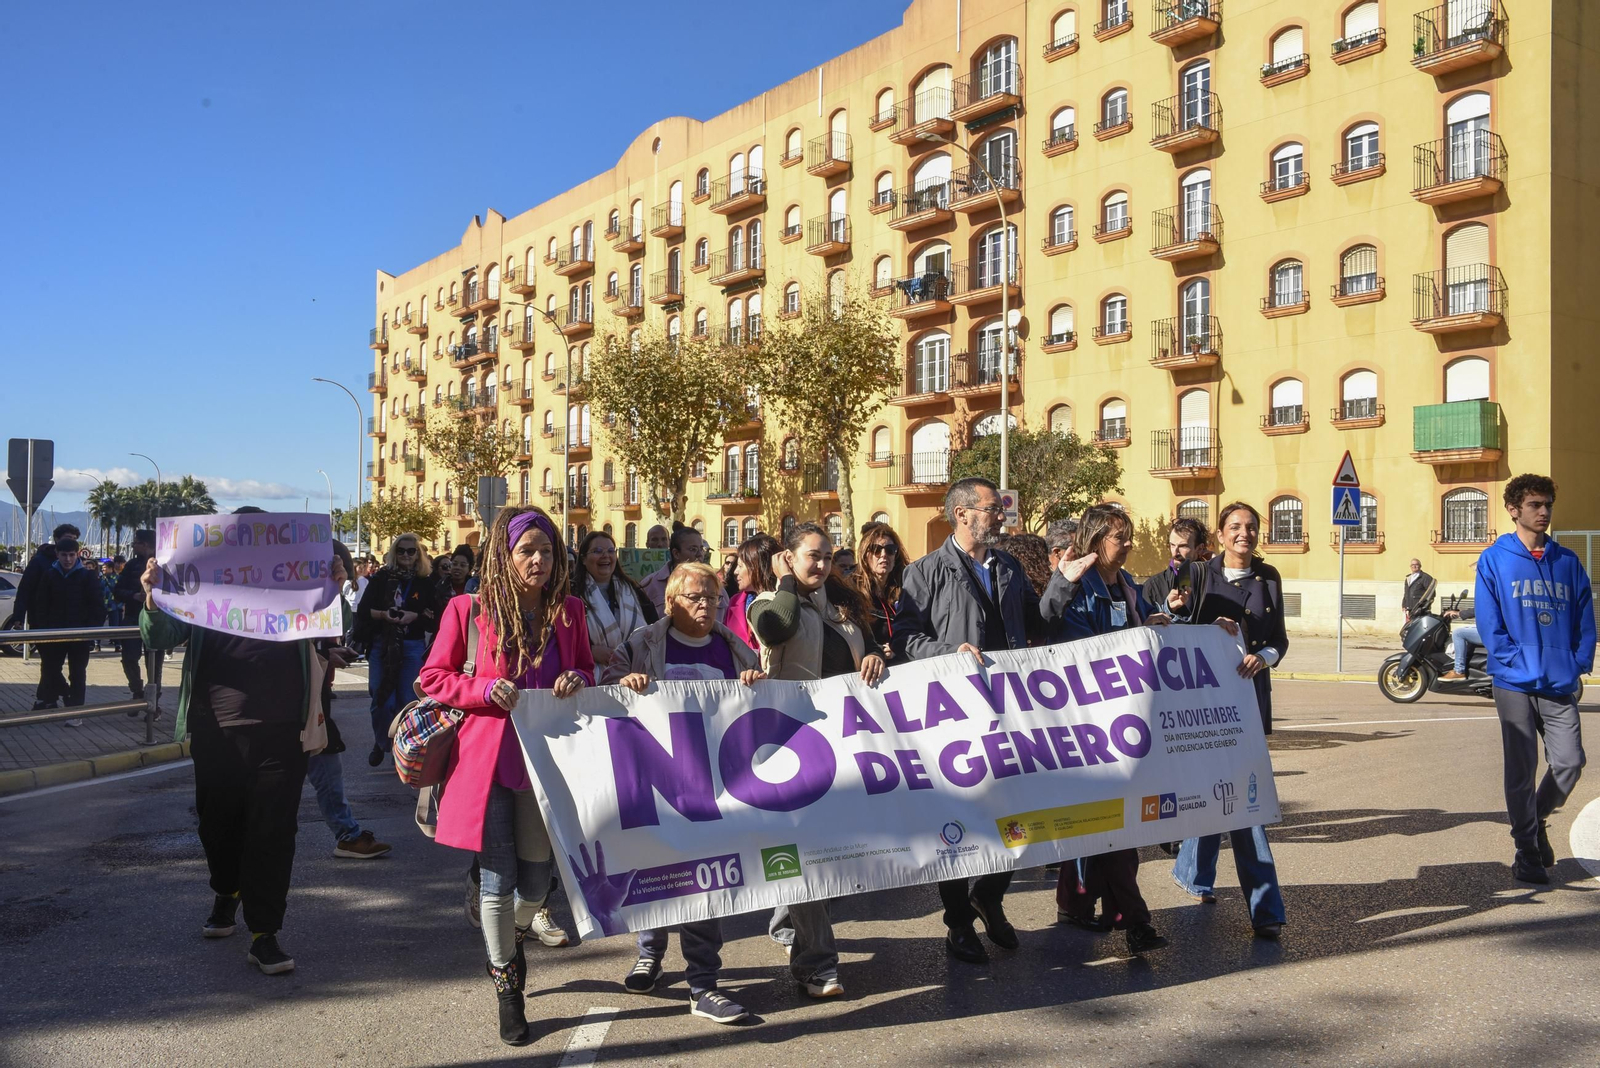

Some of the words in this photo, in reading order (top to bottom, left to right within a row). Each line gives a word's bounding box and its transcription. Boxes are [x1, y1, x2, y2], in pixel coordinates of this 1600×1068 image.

[162, 563, 200, 596] NO
[213, 568, 234, 585] ES
[239, 565, 262, 584] TU
[206, 598, 340, 635] MALTRATARME
[842, 696, 882, 737] A
[885, 680, 969, 733] LA
[965, 645, 1220, 714] VIOLENCIA
[1159, 711, 1175, 729] 25
[1176, 705, 1241, 728] NOVIEMBRE
[1164, 732, 1175, 742] DÍA
[1175, 729, 1220, 741] INTERNACIONAL
[1219, 727, 1244, 736] CONTRA
[854, 748, 934, 795] DE
[938, 713, 1152, 788] GÉNERO
[1166, 745, 1175, 754] LA
[1174, 743, 1204, 753] VIOLENCIA
[1205, 741, 1213, 750] DE
[1213, 738, 1238, 748] GÉNERO
[605, 707, 837, 830] NO
[1145, 803, 1156, 815] IC
[1179, 801, 1207, 811] IGUALDAD
[805, 856, 834, 866] CONSEJERÍA
[841, 851, 865, 860] IGUALDAD
[869, 848, 891, 856] POLÍTICAS
[957, 844, 979, 853] Estado
[638, 875, 661, 885] Teléfono
[669, 870, 692, 880] Atención
[695, 857, 740, 890] 016
[641, 883, 666, 894] Violencia
[674, 879, 694, 888] Género
